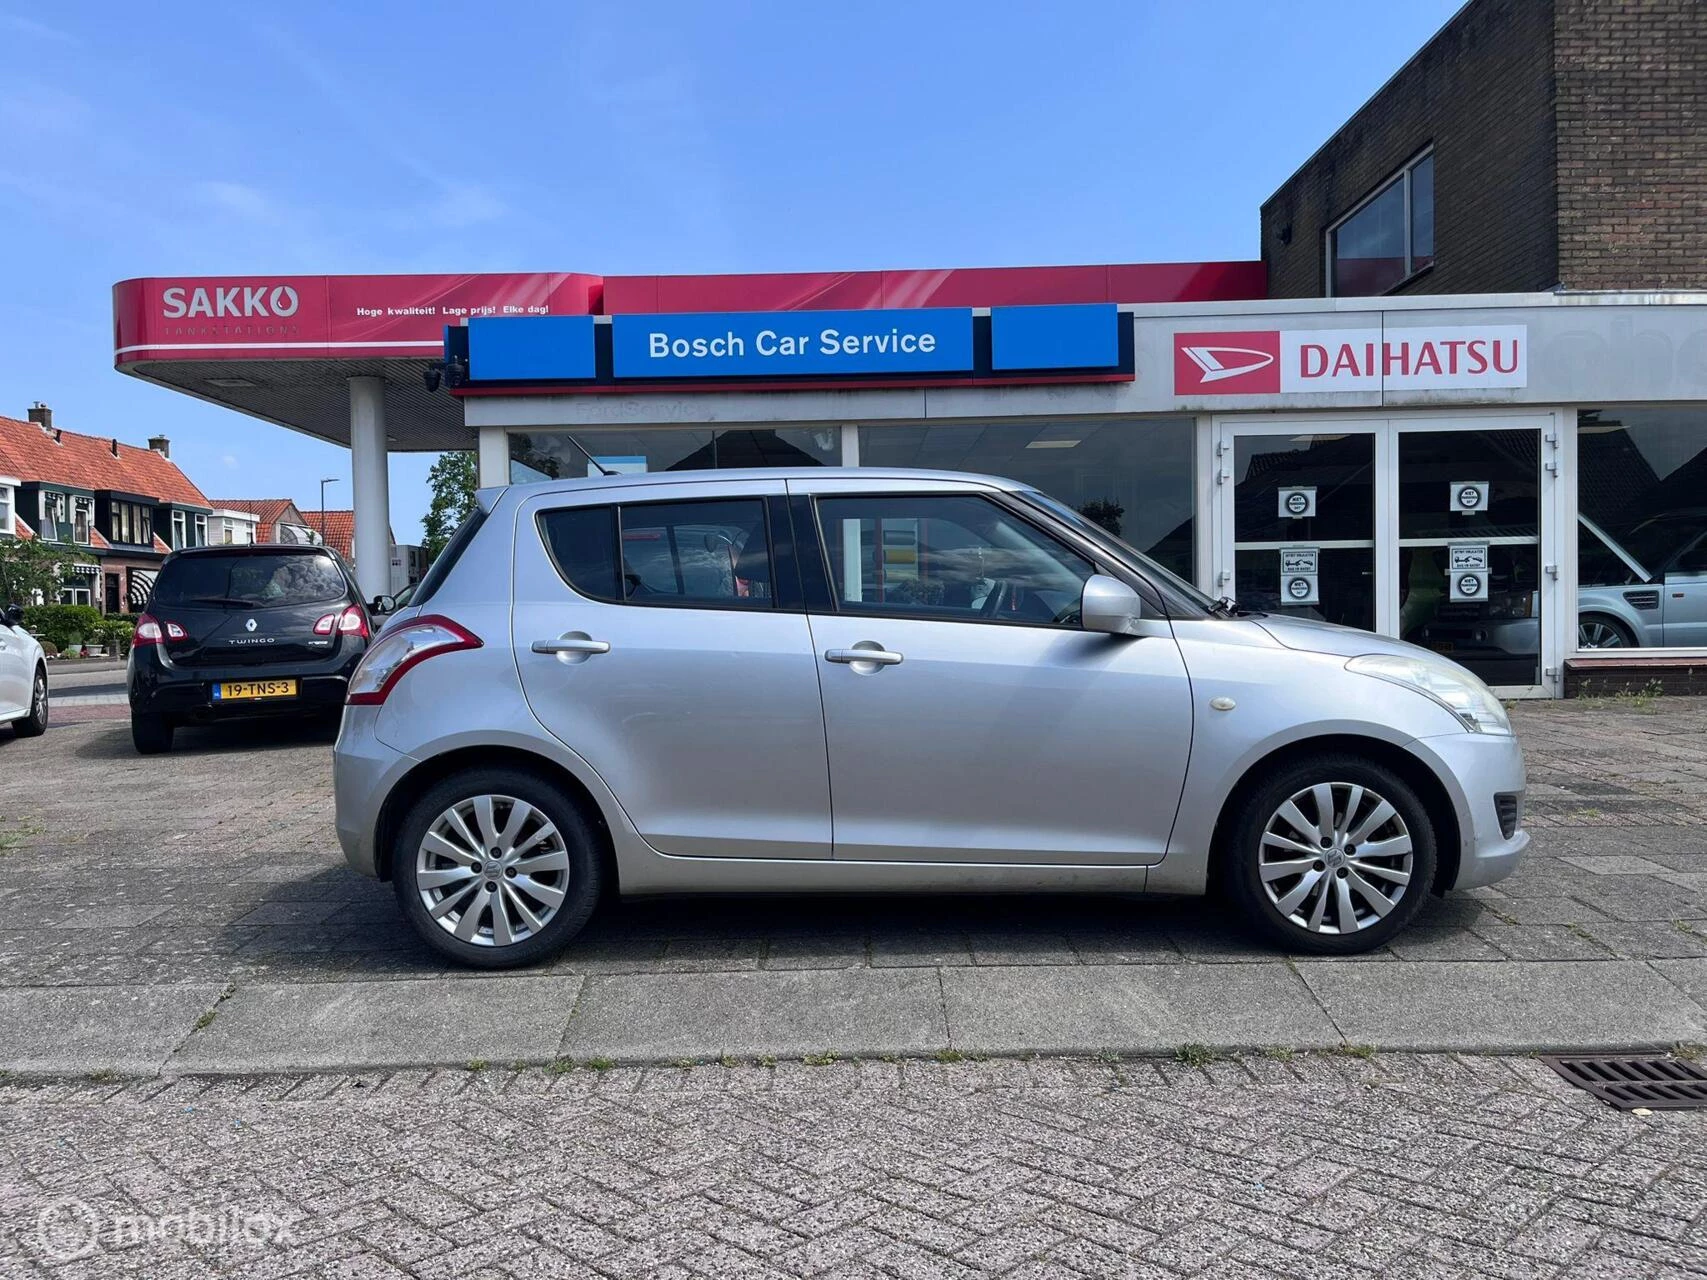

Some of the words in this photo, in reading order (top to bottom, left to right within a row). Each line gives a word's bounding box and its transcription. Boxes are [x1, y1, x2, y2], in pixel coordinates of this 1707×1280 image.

[163, 286, 299, 318] SAKKO
[357, 307, 383, 316] Hoge
[387, 307, 435, 315] kwaliteit!
[442, 307, 467, 316] Lage
[470, 306, 496, 316] prijs!
[527, 305, 549, 315] dag!
[649, 331, 745, 358] Bosch
[755, 330, 810, 356] Car
[820, 328, 936, 355] Service
[1300, 340, 1518, 377] DAIHATSU
[227, 681, 289, 697] 19-TNS-3
